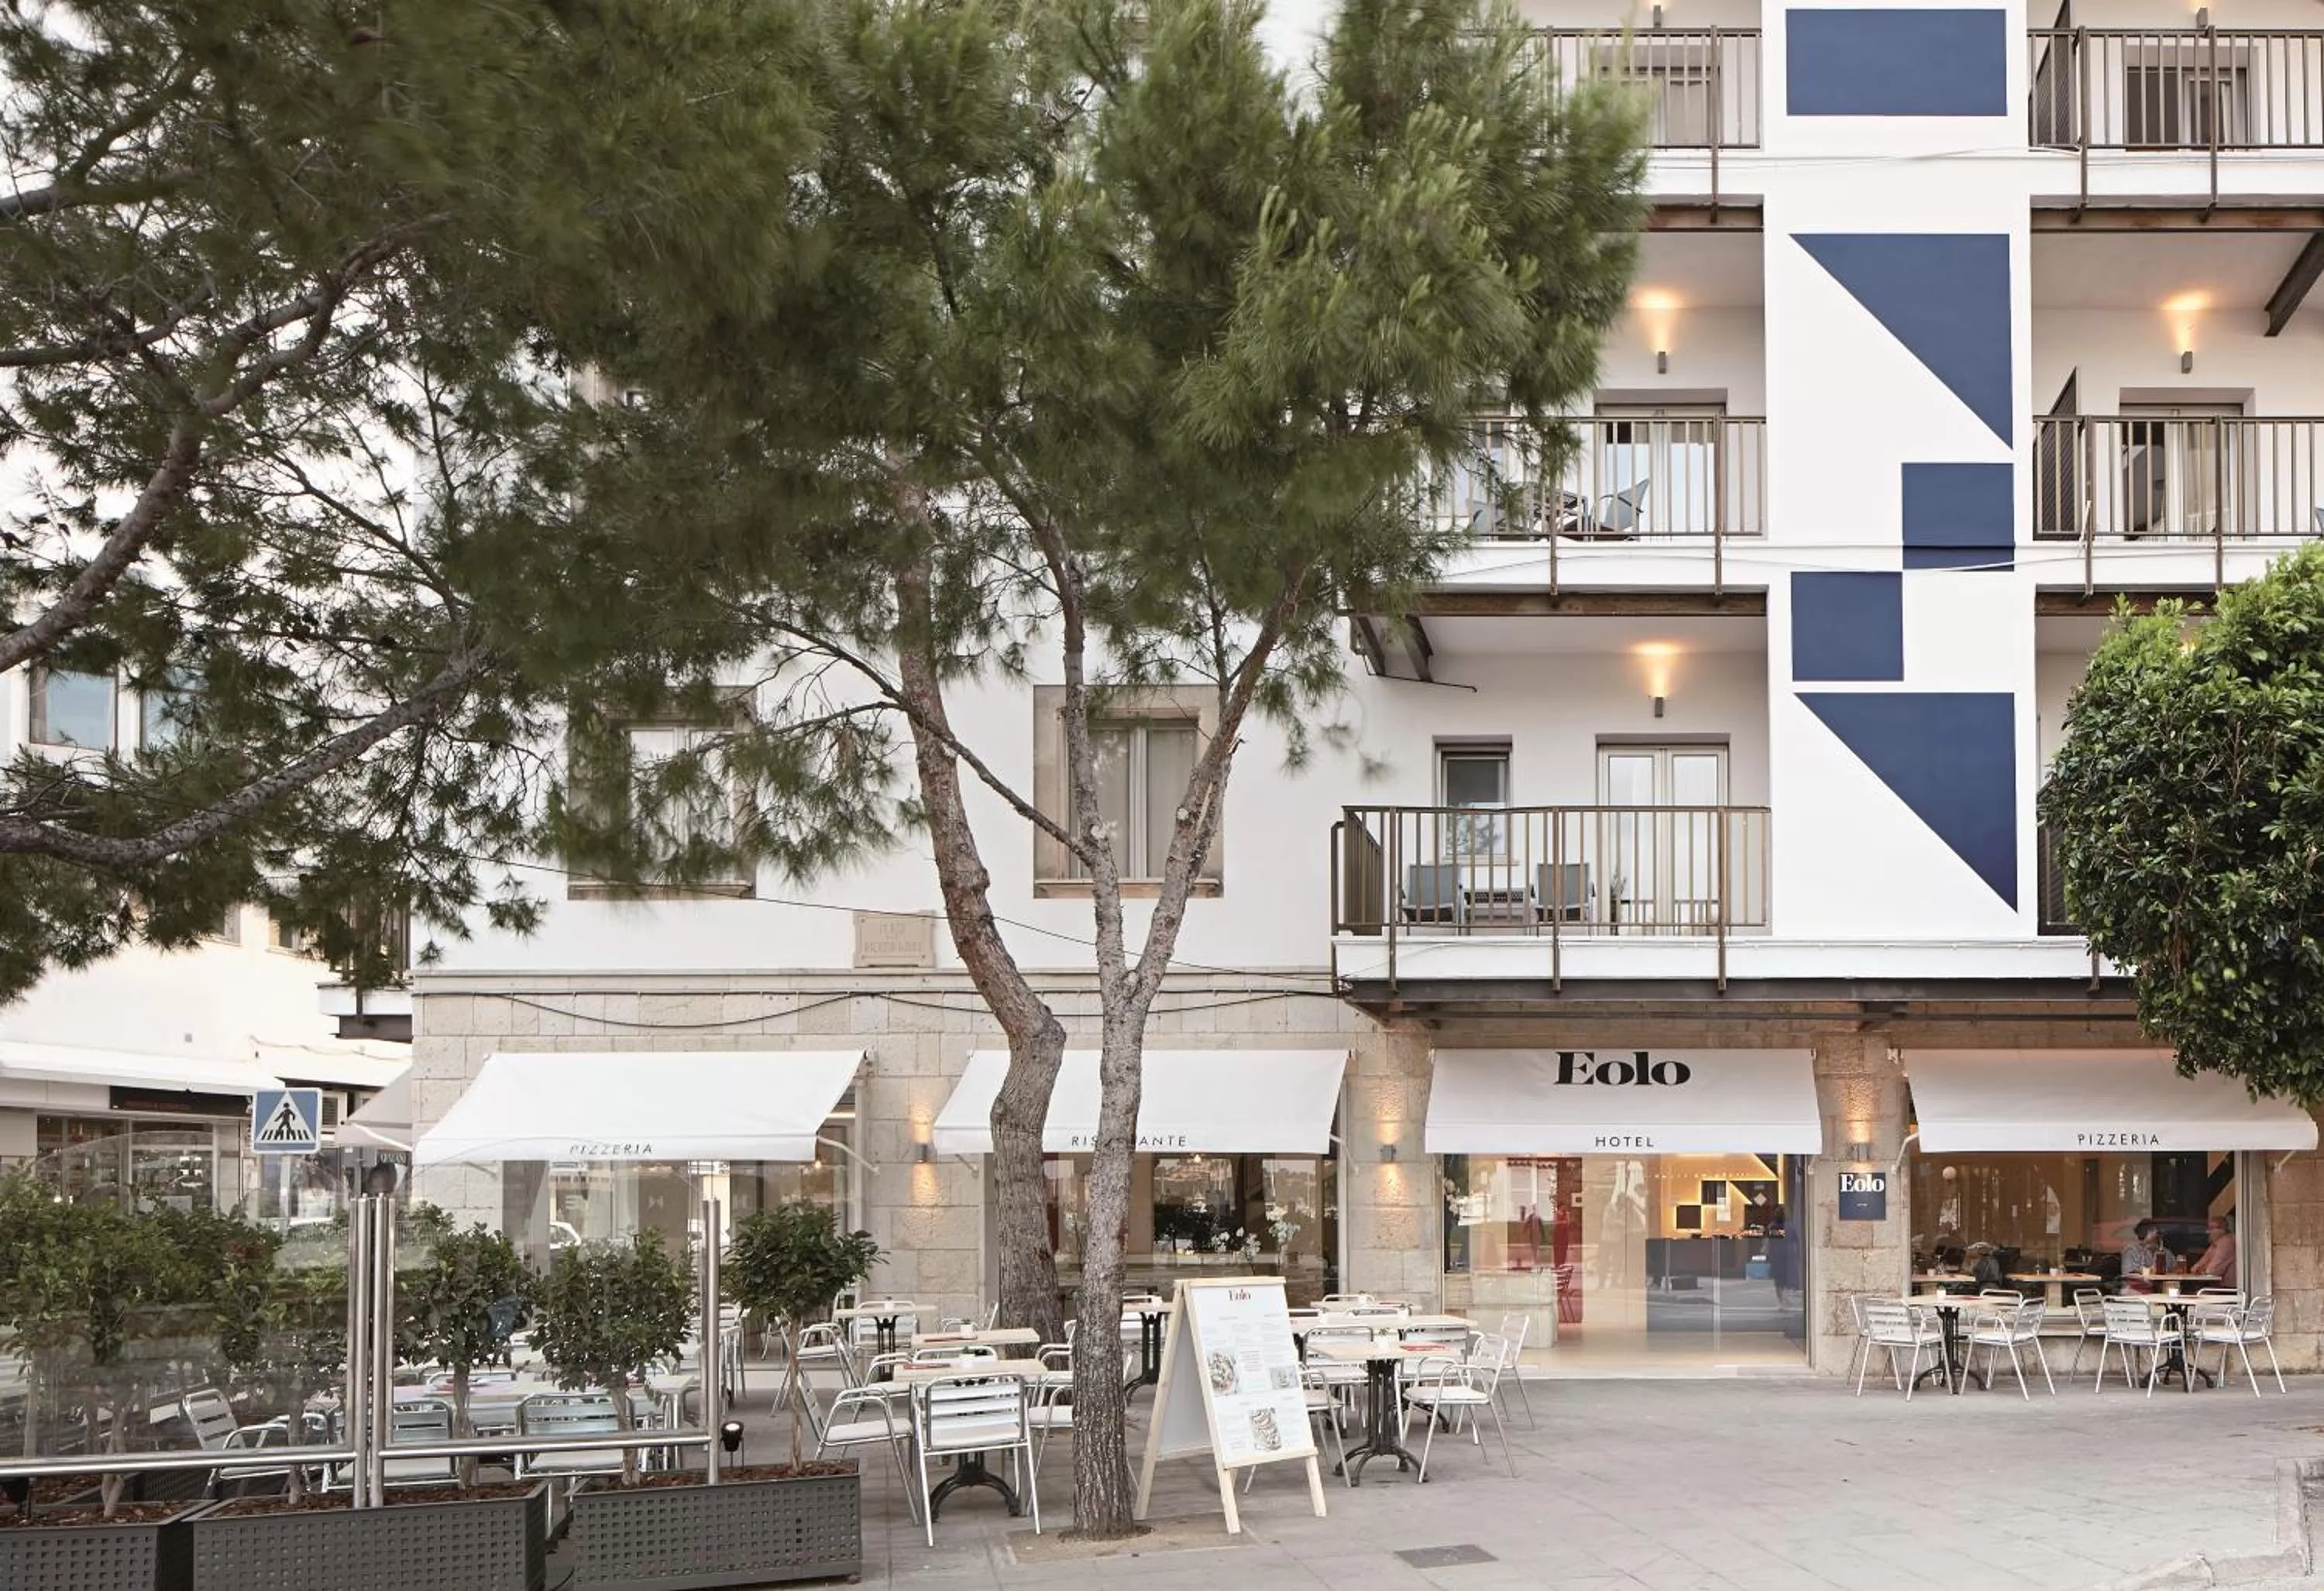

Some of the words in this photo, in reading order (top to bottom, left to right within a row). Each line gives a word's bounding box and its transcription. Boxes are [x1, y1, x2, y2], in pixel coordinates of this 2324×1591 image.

[1553, 1050, 1692, 1086] Eolo
[1071, 1135, 1187, 1148] RISANTE
[1594, 1136, 1655, 1148] HOTEL
[2077, 1133, 2160, 1146] PIZZERIA
[569, 1143, 652, 1155] PIZZERIA
[1840, 1173, 1886, 1192] Eolo
